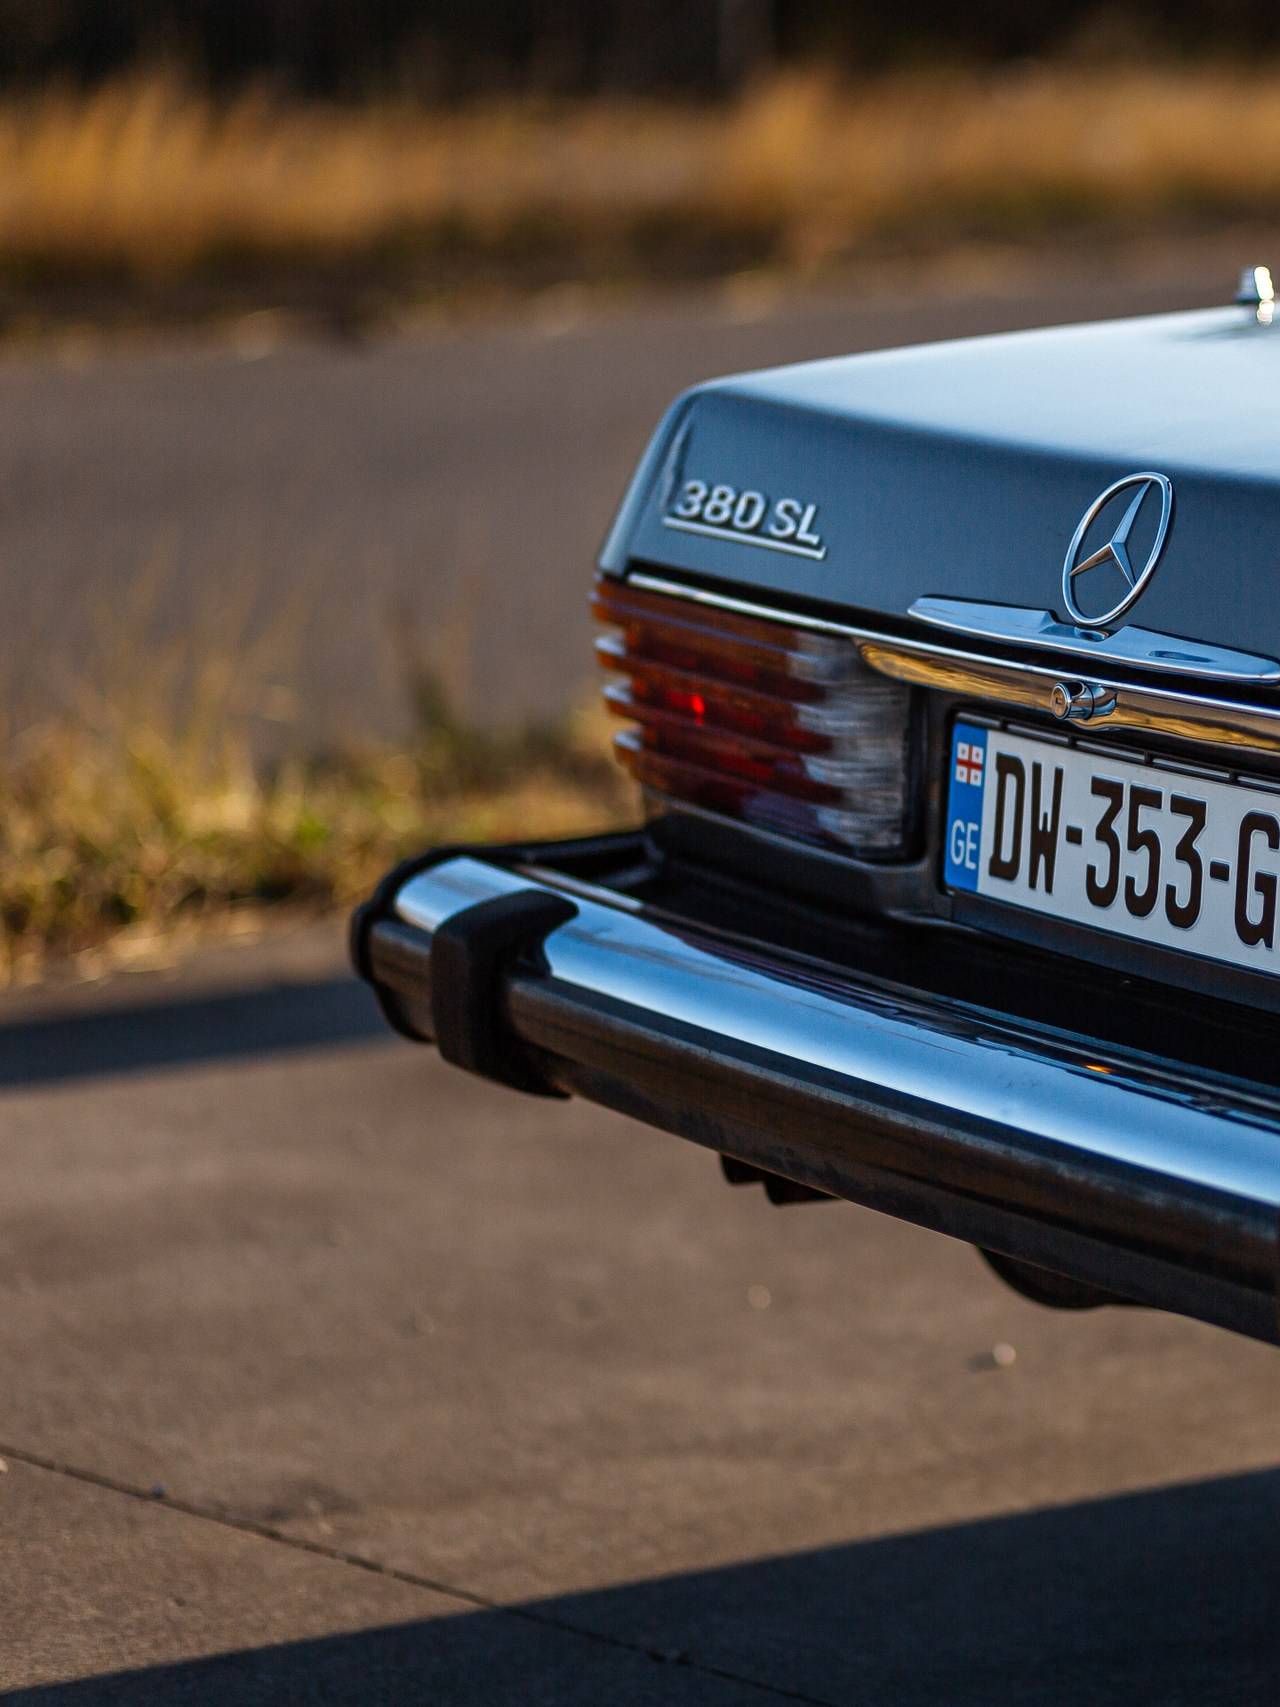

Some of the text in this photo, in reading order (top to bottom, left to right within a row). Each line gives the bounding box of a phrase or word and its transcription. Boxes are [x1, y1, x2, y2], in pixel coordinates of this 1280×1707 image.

[675, 480, 820, 545] 380 SL
[951, 819, 979, 870] GE
